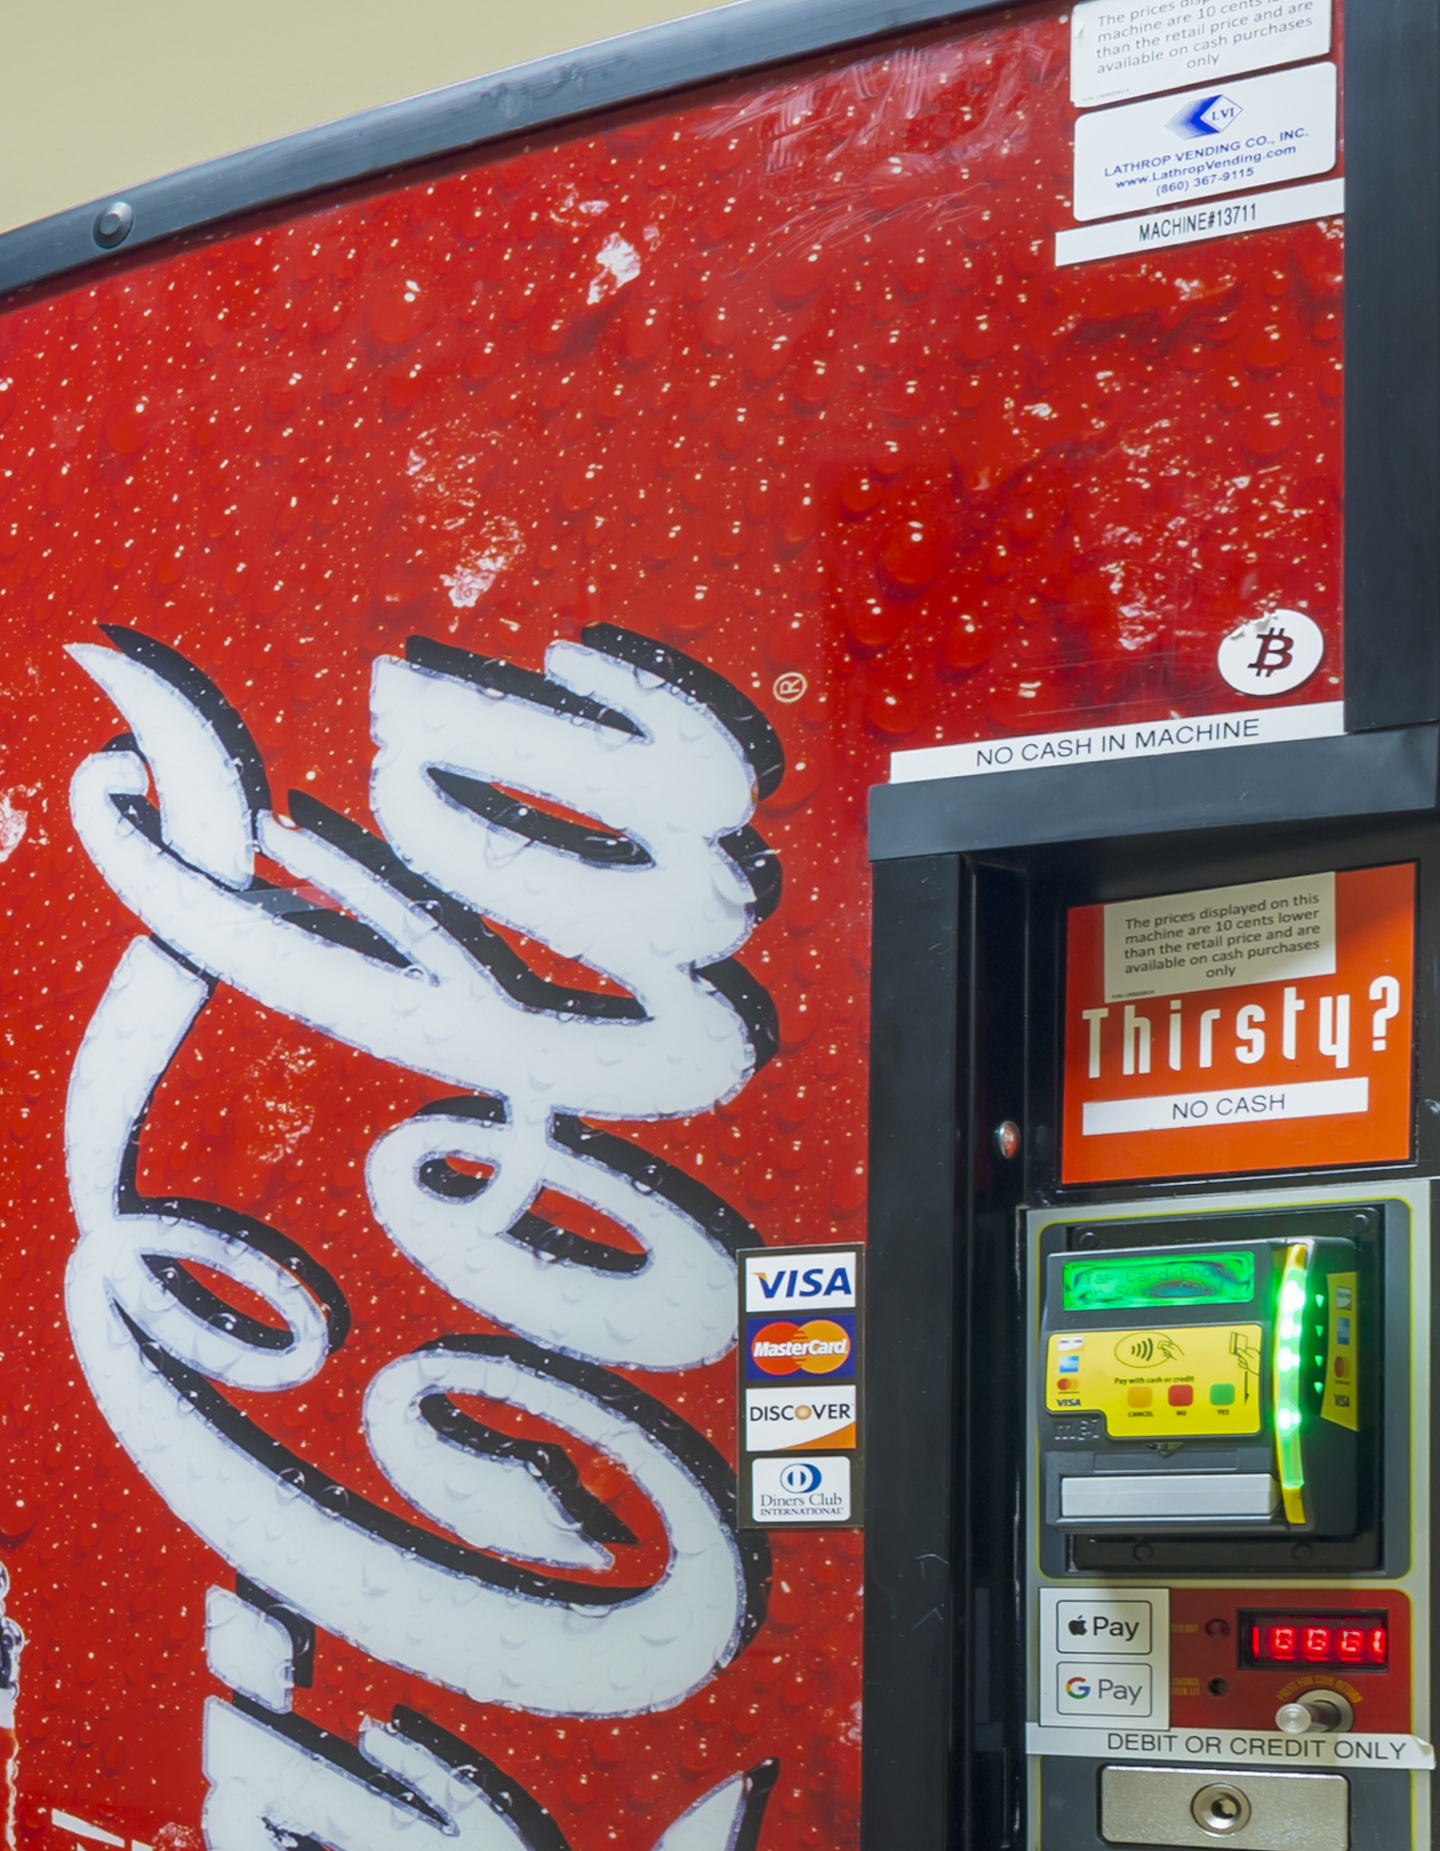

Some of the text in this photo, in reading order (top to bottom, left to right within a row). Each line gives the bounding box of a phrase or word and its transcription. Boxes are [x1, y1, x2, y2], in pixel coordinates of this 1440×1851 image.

[1096, 40, 1130, 59] than
[1136, 35, 1160, 50] the
[1166, 25, 1205, 43] retail
[1211, 16, 1248, 35] price
[1253, 7, 1283, 23] and
[1288, 1, 1313, 13] are
[1097, 16, 1312, 75] available on cash purchases
[1186, 53, 1220, 70] only
[1211, 108, 1235, 121] LVI
[1104, 128, 1308, 177] LATHROP VENDING CO., INC.
[1116, 145, 1296, 189] www.LathropVending.com
[1156, 167, 1253, 196] (860) 367-9115
[1139, 203, 1256, 242] MACHINE#13711
[976, 718, 1259, 767] NO CASH IN MACHINE
[1125, 893, 1319, 930] The prices displayed on this
[1125, 908, 1320, 944] machine are 10 cents lower
[1124, 923, 1321, 959] than the retail price and are
[1124, 939, 1320, 974] available on cash purchases
[1206, 964, 1236, 978] only
[1082, 975, 1400, 1079] Thirsty?
[1173, 1094, 1285, 1120] NO CASH
[750, 1267, 852, 1299] VISA
[753, 1339, 848, 1358] MasterCard
[750, 1403, 851, 1422] DISCOVER
[760, 1507, 843, 1516] INTERNATIONAL
[761, 1492, 842, 1507] Diners Club
[1092, 1616, 1140, 1642] Pay
[1098, 1678, 1143, 1705] Pay
[1107, 1733, 1407, 1760] DEBIT OR CREDIT ONLY
